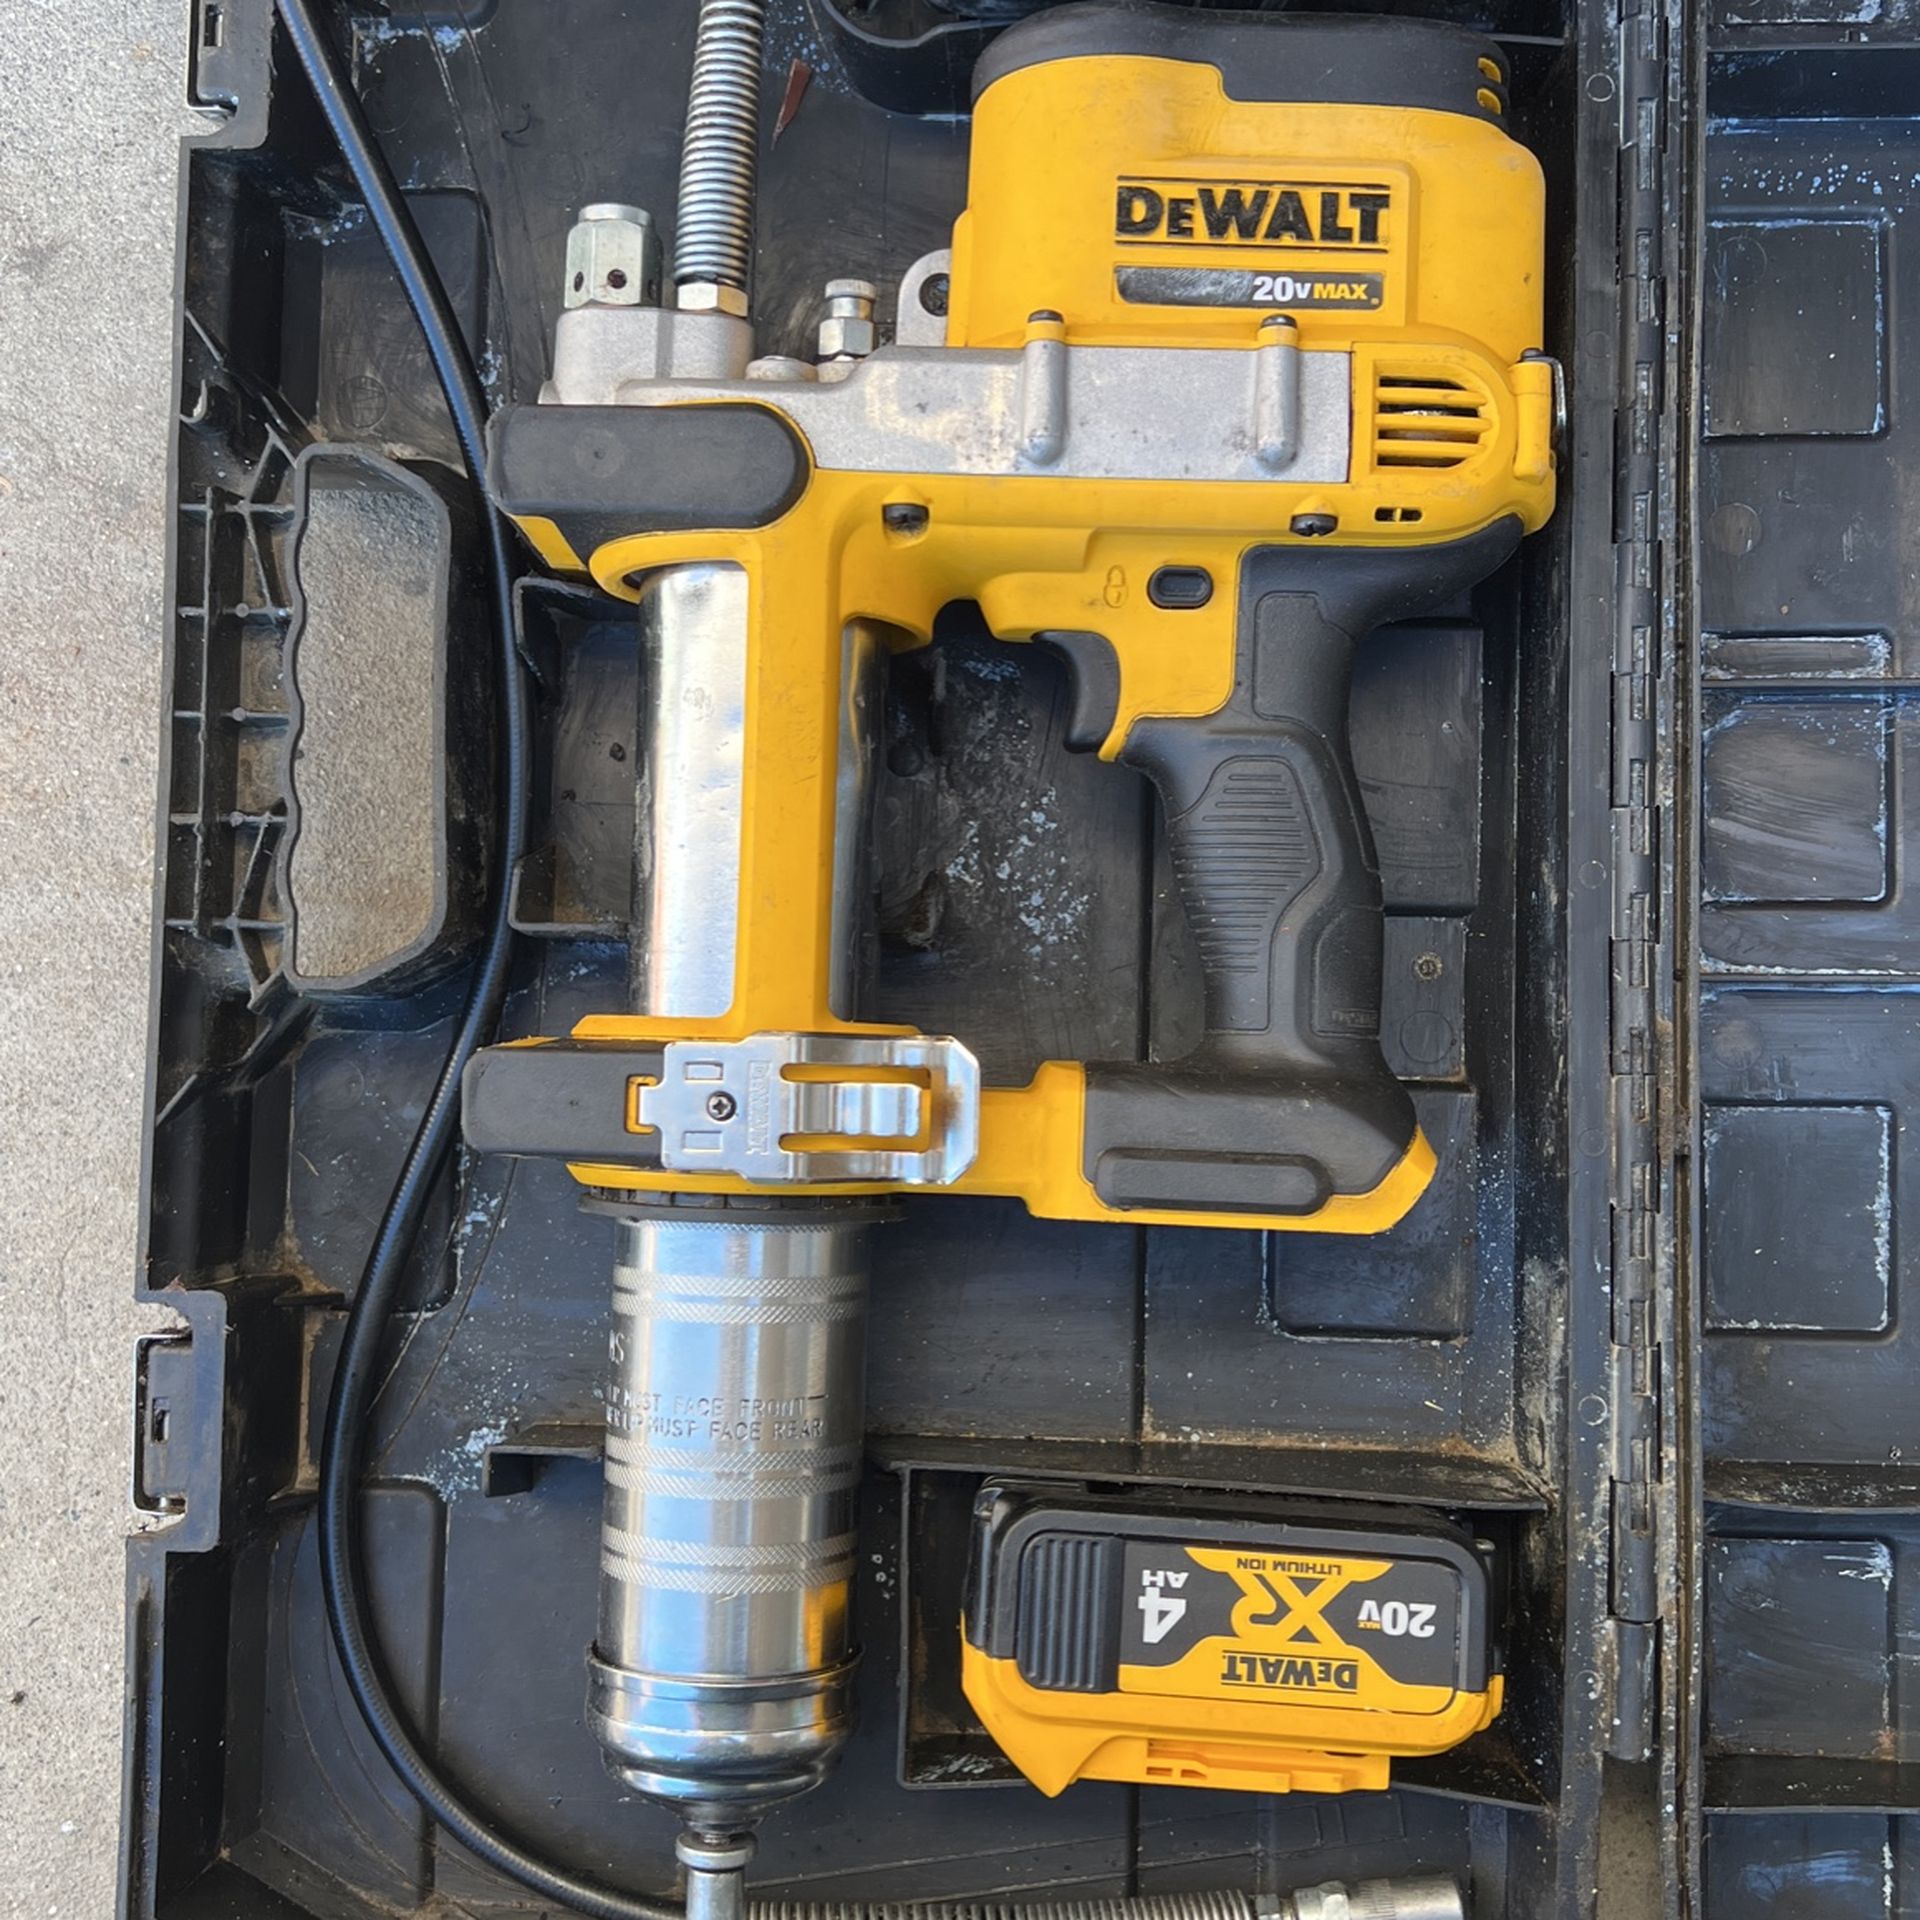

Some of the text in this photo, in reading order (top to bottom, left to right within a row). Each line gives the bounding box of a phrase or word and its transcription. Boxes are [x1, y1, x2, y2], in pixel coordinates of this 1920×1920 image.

[1116, 186, 1390, 243] DEWALT
[1313, 282, 1368, 300] MAX
[673, 1395, 724, 1417] FACE
[709, 1419, 762, 1441] FACE
[773, 1418, 825, 1441] REAR
[1236, 1557, 1342, 1577] LITHIUM ION
[1141, 1569, 1190, 1589] AH
[1137, 1586, 1187, 1645] 4
[1221, 1654, 1358, 1691] DEWALT
